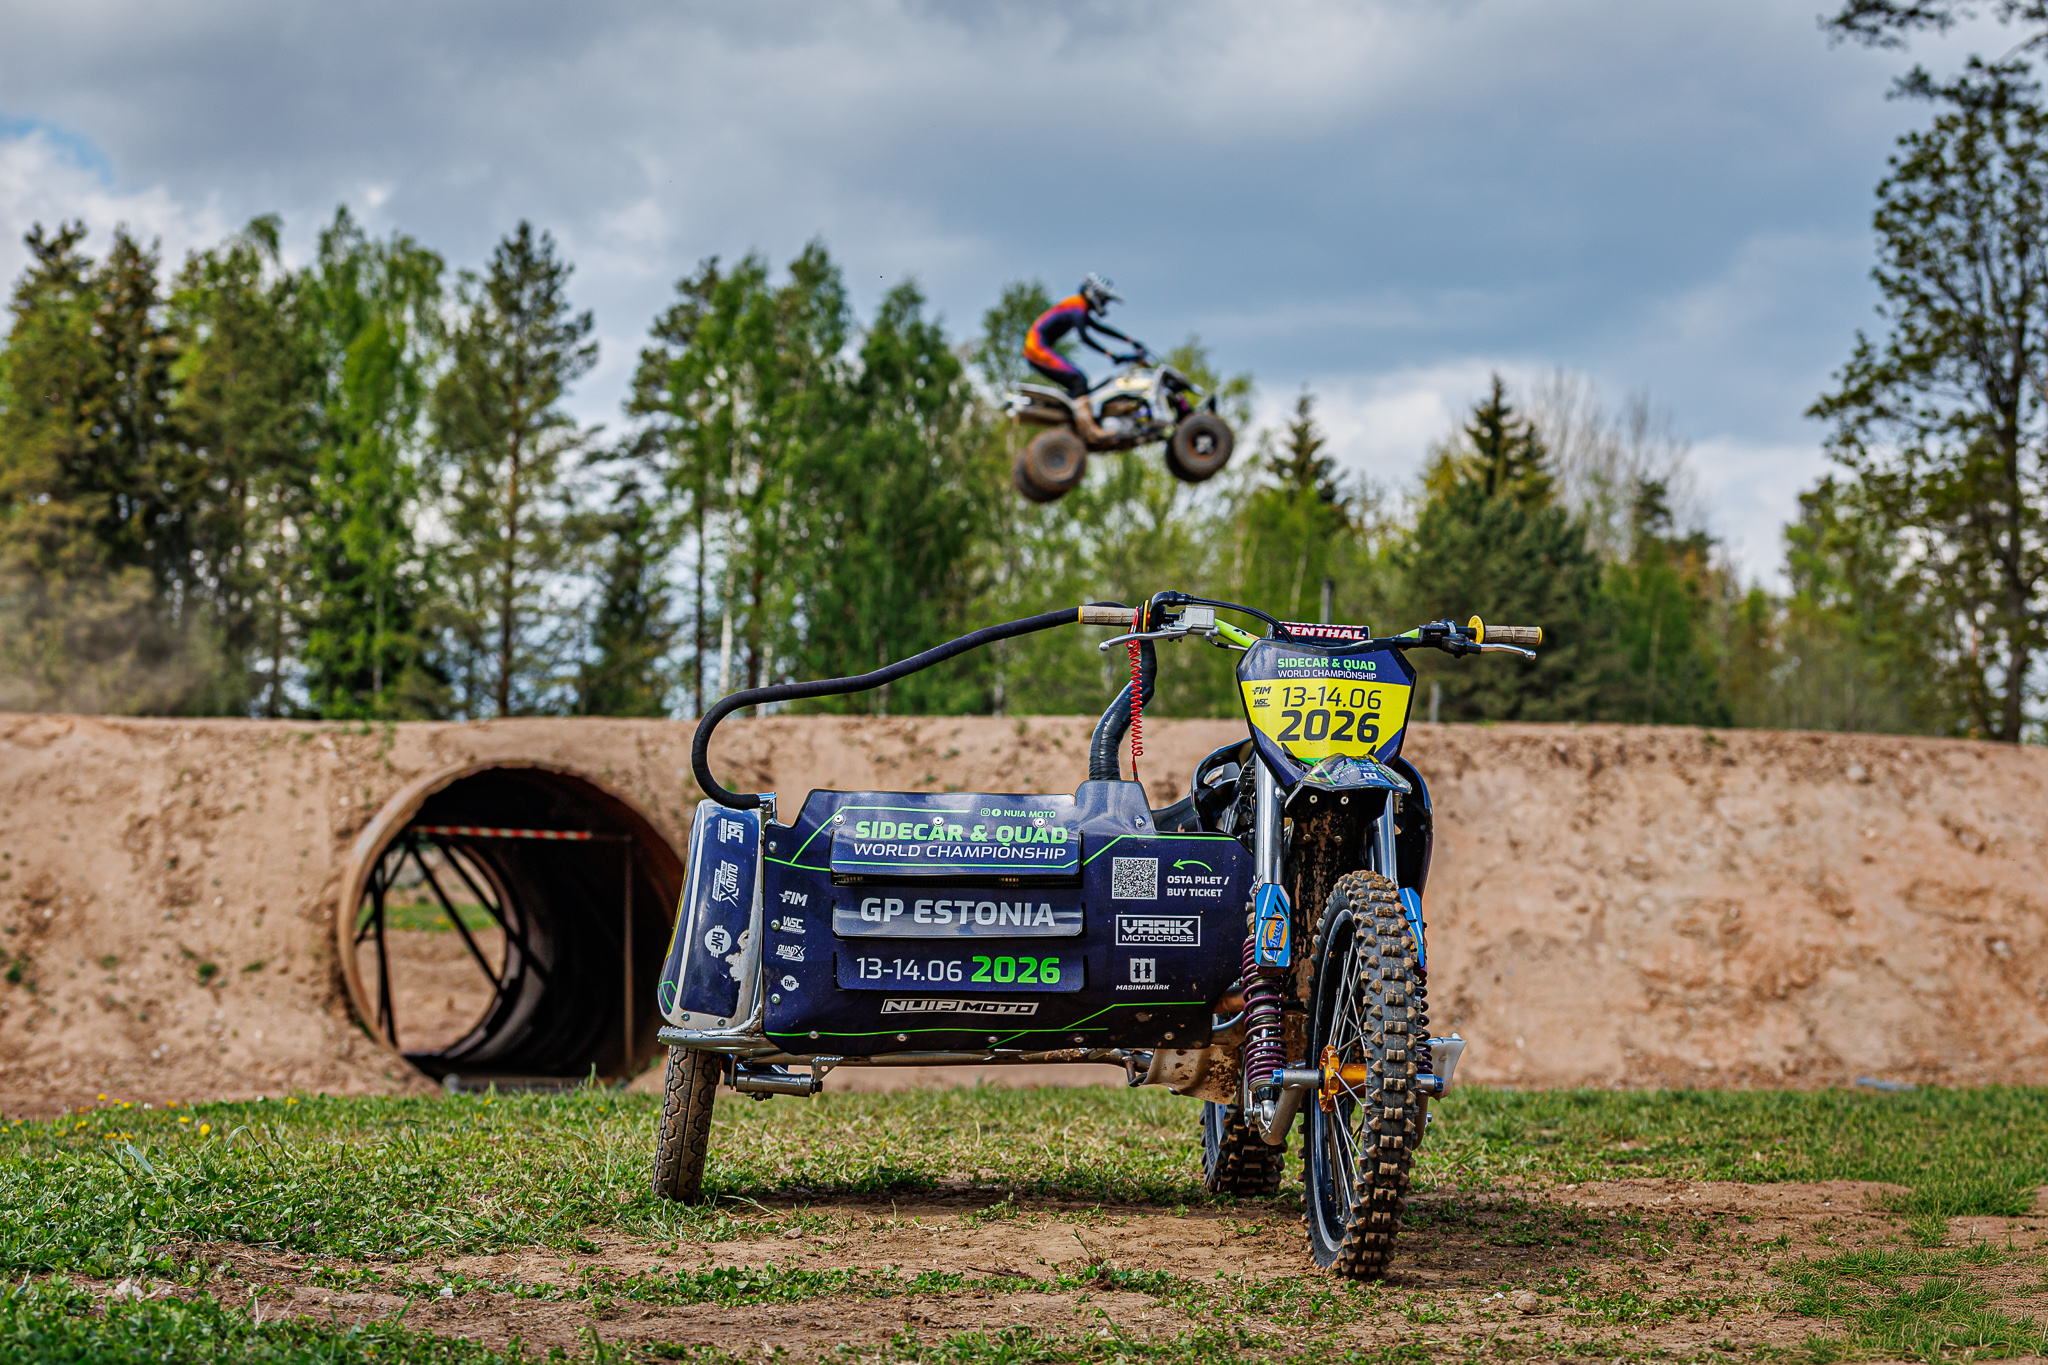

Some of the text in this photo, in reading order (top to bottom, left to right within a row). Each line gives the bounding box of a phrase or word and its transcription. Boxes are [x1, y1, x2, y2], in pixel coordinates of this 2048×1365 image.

[1277, 657, 1377, 671] SIDECAR & QUAD
[1277, 669, 1377, 680] WORLD CHAMPIONSHIP
[1251, 686, 1271, 695] FIM
[1283, 686, 1382, 710] 13-14.06
[1277, 709, 1380, 743] 2026
[1003, 809, 1056, 819] NUIA MOTO
[855, 820, 1068, 847] SIDECAR & QUAD
[853, 843, 1066, 860] WORLD CHAMPIONSHIP
[1167, 875, 1230, 885] OSTA PILET /
[778, 890, 808, 907] FIM
[1166, 887, 1223, 897] BUY TICKET
[860, 897, 1056, 927] GP ESTONIA
[782, 915, 804, 929] WSC
[1122, 919, 1194, 935] VARIK
[1121, 934, 1195, 942] MOTOCROSS
[856, 956, 1061, 984] 13-14.06 2026
[1115, 983, 1170, 991] MASINAWÄRK
[961, 1002, 1034, 1014] MOTO
